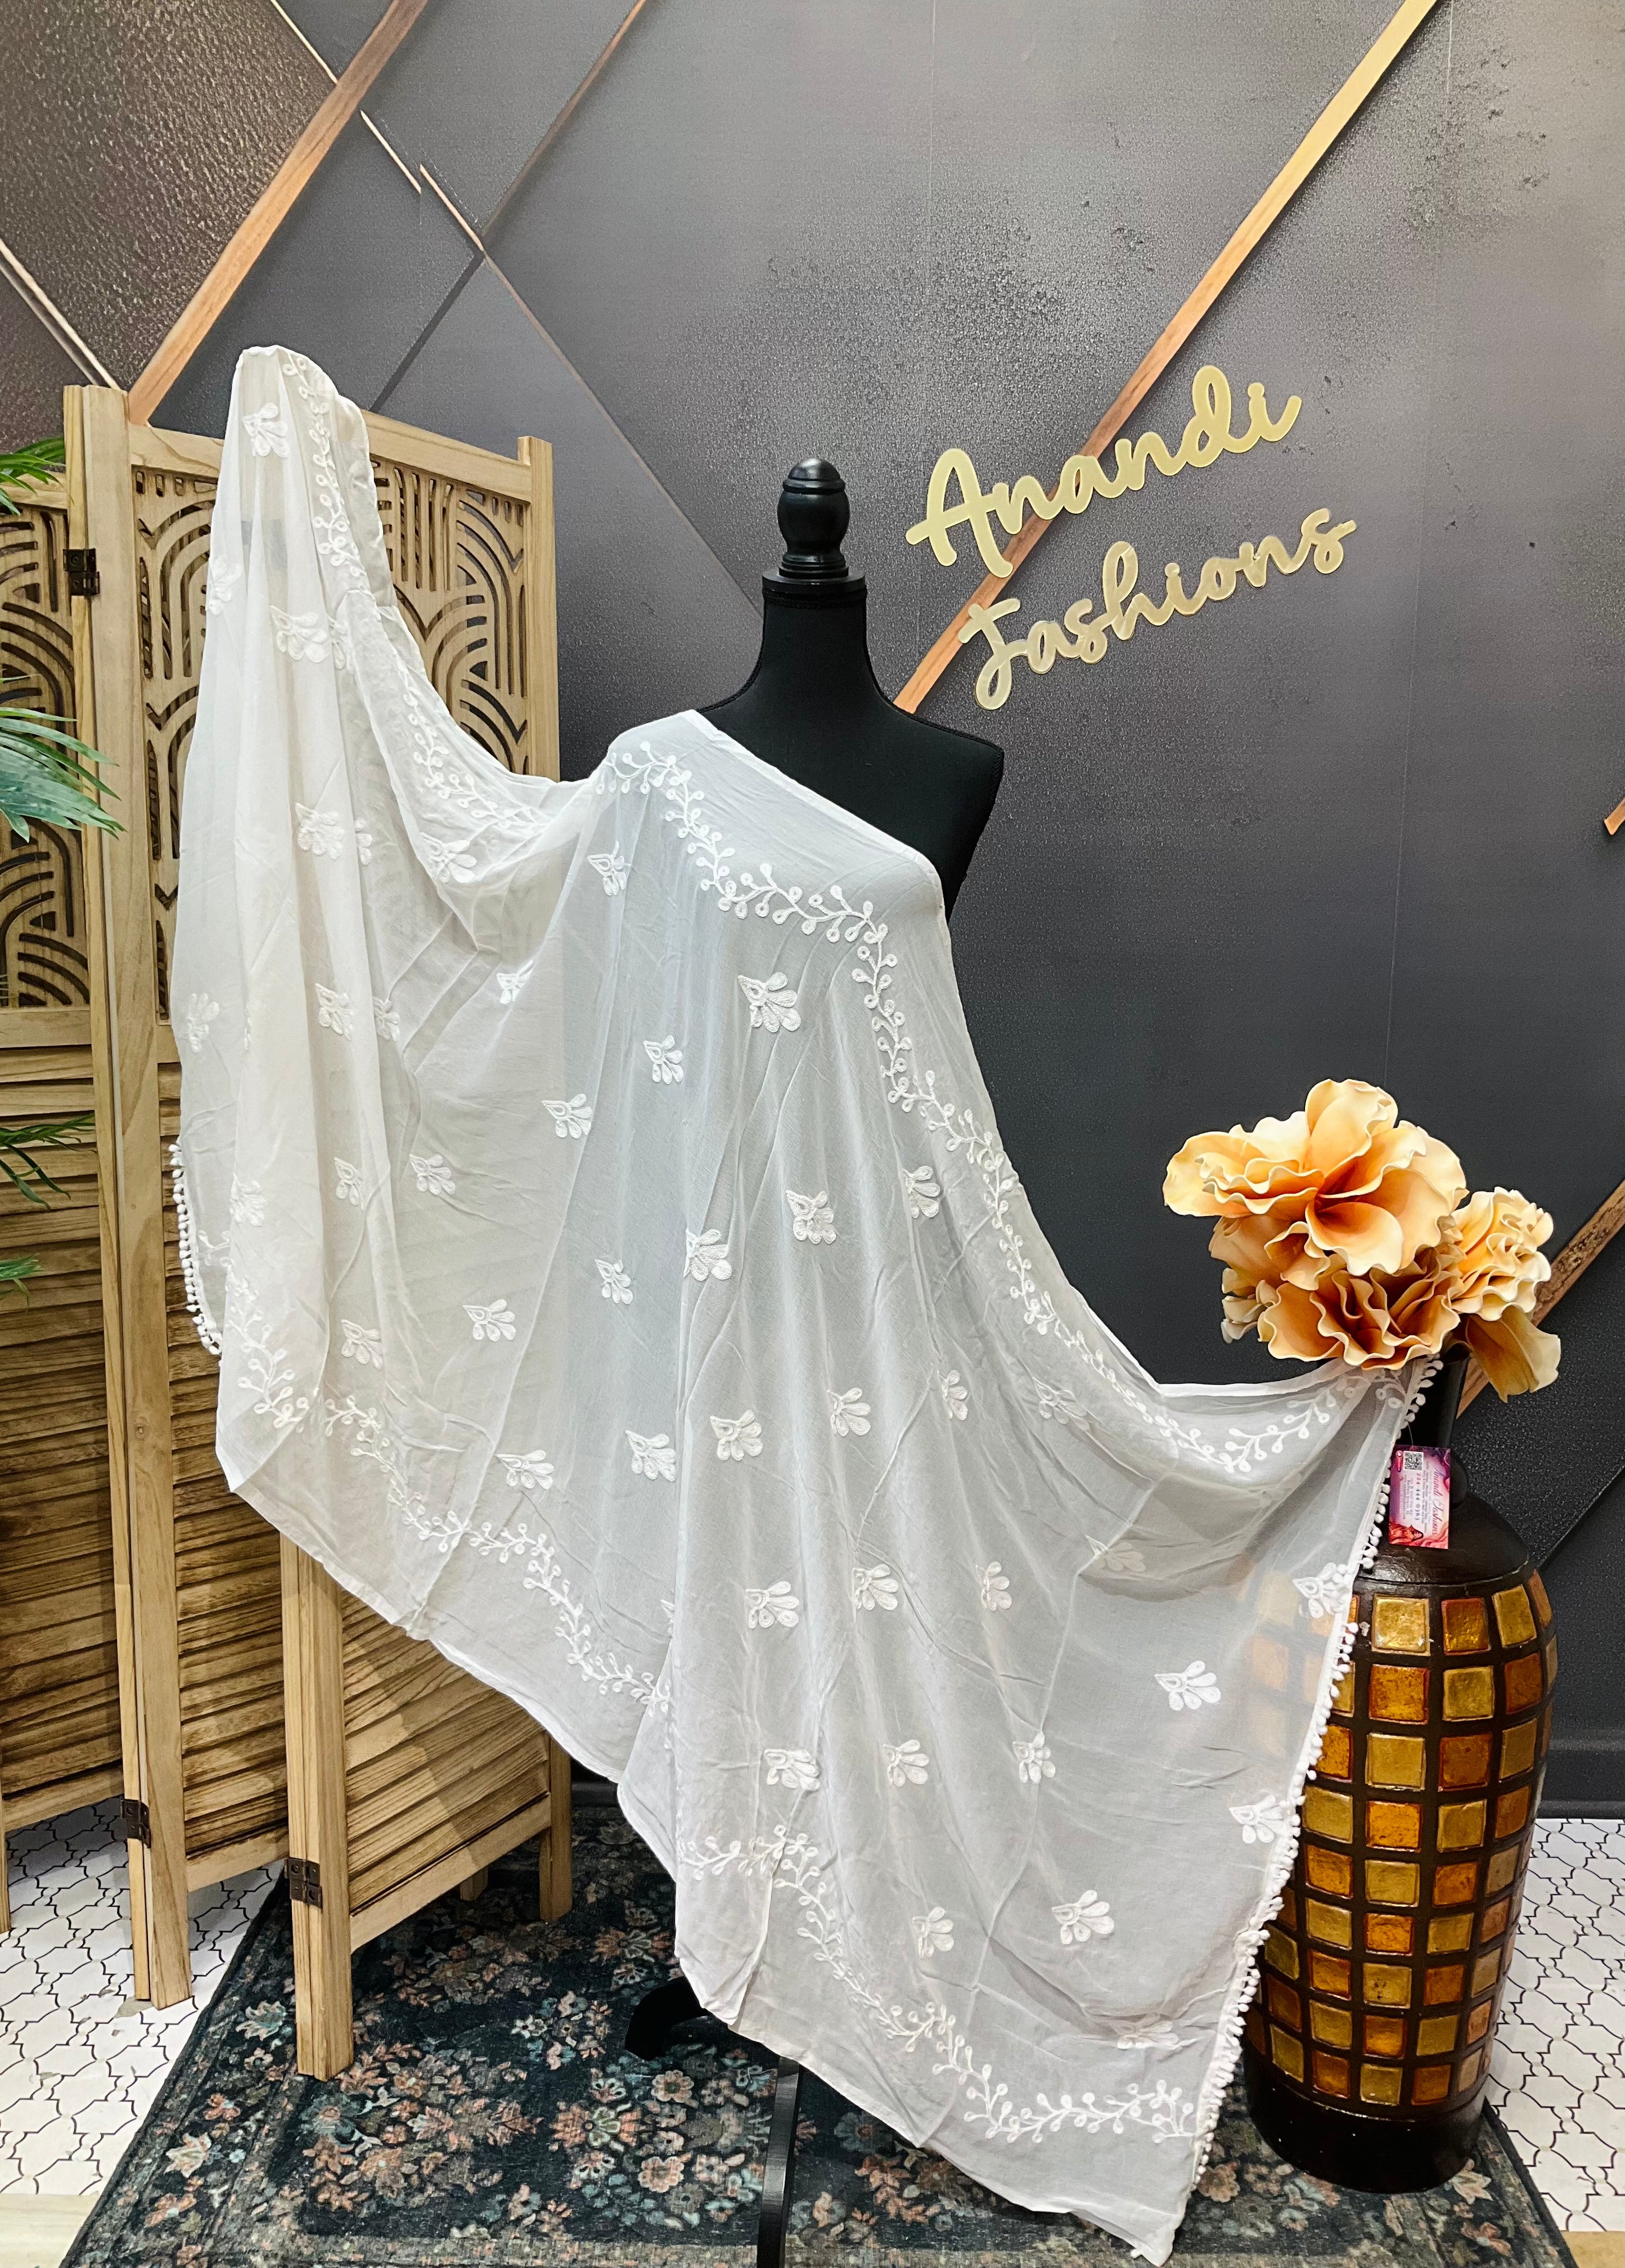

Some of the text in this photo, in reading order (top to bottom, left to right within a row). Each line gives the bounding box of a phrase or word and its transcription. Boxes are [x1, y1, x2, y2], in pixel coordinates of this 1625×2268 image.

[906, 365, 1302, 578] Anandi
[958, 508, 1357, 710] Fashions
[1432, 1468, 1445, 1535] Anandi Fashions
